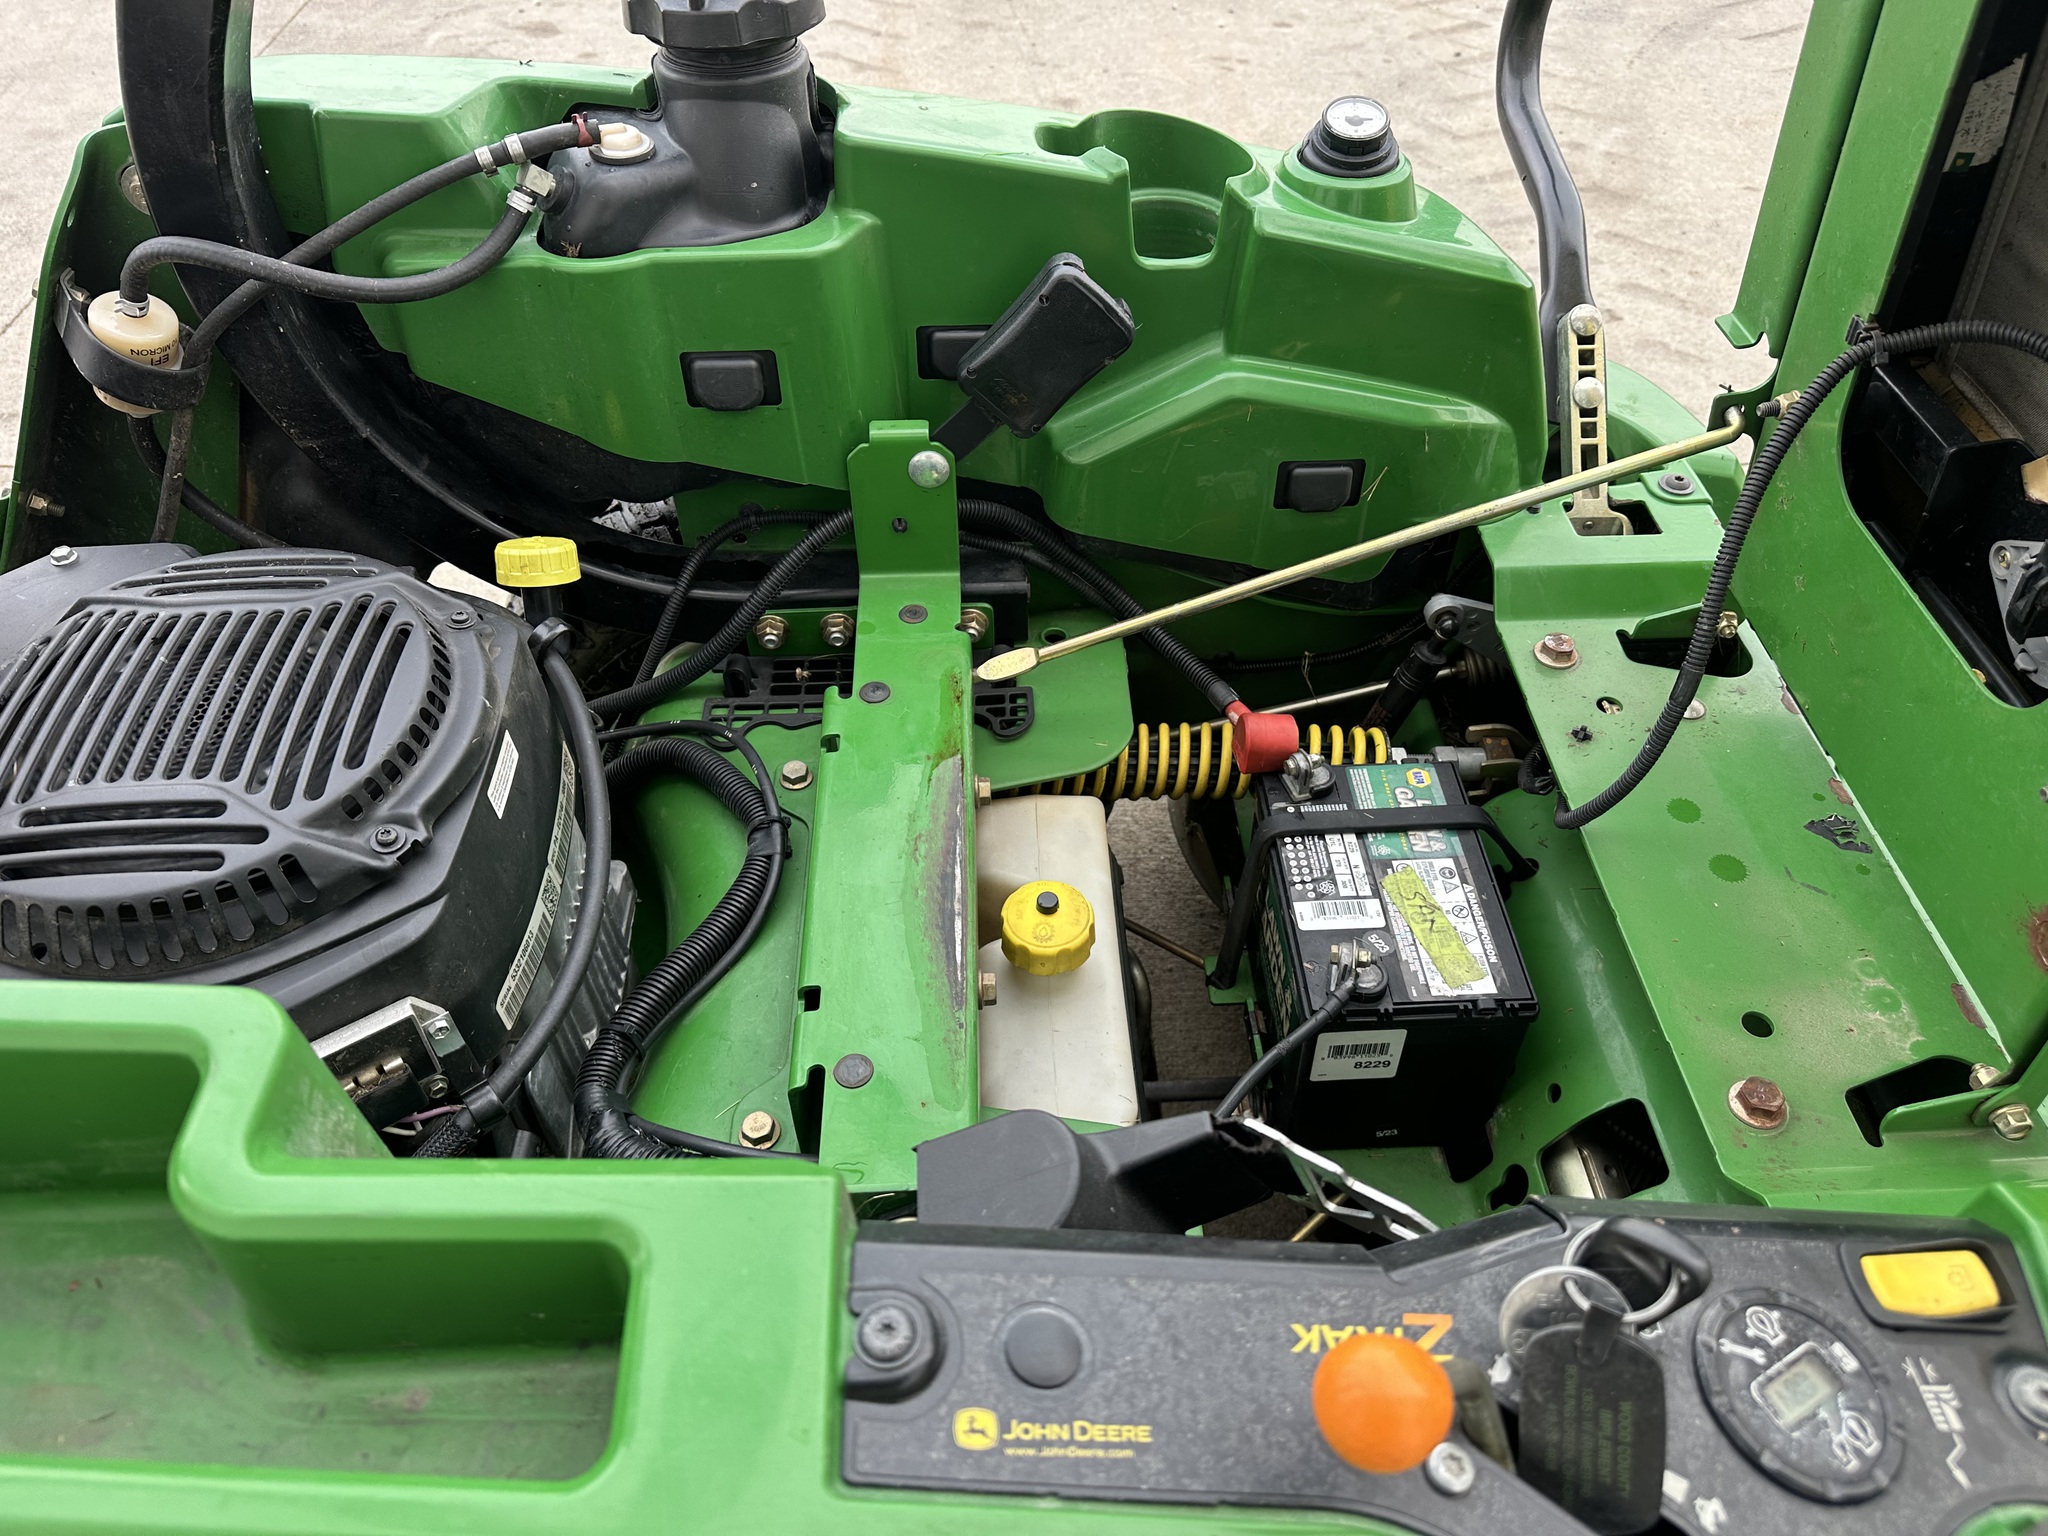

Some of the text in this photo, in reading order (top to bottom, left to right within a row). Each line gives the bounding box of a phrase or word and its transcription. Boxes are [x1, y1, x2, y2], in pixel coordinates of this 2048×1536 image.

[130, 343, 170, 356] MICRON
[150, 353, 169, 366] EFI
[1412, 771, 1424, 785] NAPA
[1466, 892, 1498, 962] DANGER/POISON
[1367, 933, 1390, 953] 5/23
[498, 984, 512, 1009] SERIAL
[1354, 1061, 1391, 1069] 8229
[1376, 1129, 1398, 1137] 5/23
[1564, 1364, 1576, 1417] BOWLING
[1002, 1420, 1153, 1443] JOHN DEERE
[1597, 1409, 1612, 1484] IMPLEMENT
[1617, 1401, 1631, 1498] WOOD COUNTY
